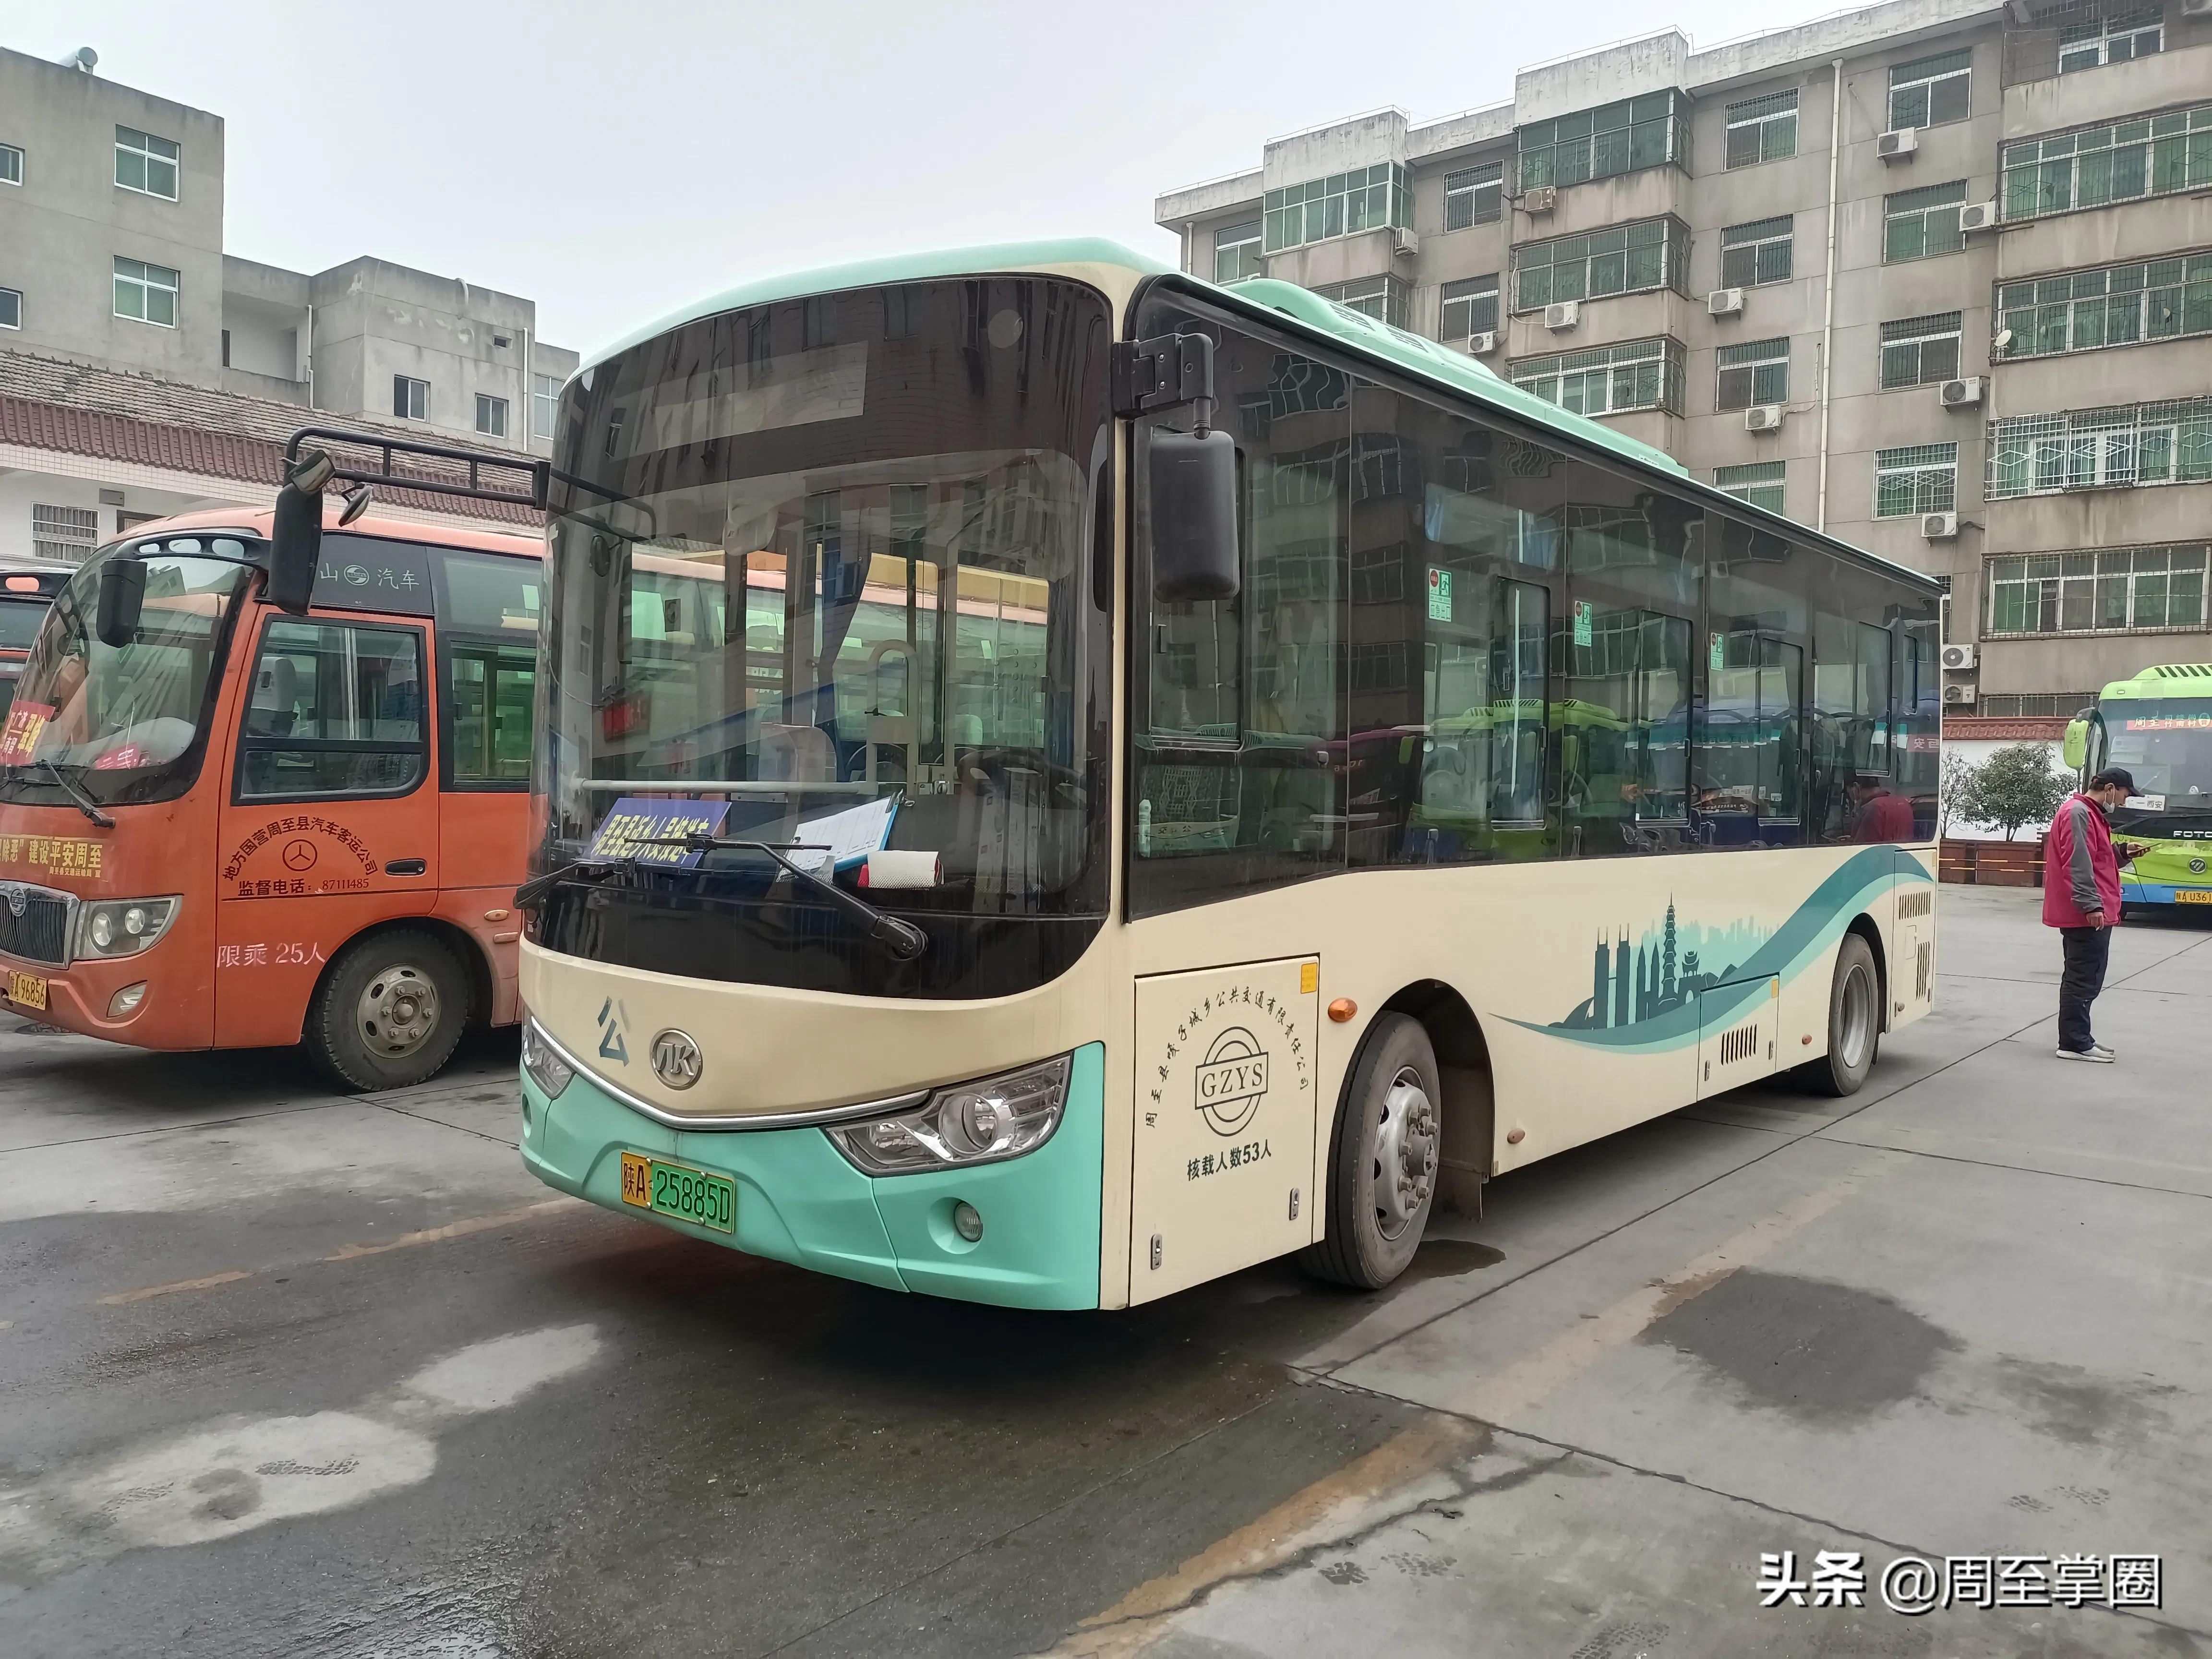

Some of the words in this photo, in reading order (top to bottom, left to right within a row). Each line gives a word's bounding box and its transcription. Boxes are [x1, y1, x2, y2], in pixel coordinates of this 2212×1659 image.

[377, 568, 420, 591] 汽车
[222, 816, 378, 881] 地方国营周至县汽车客运公司
[1202, 1062, 1263, 1098] GZYS
[1187, 1139, 1272, 1182] 核载人数53人
